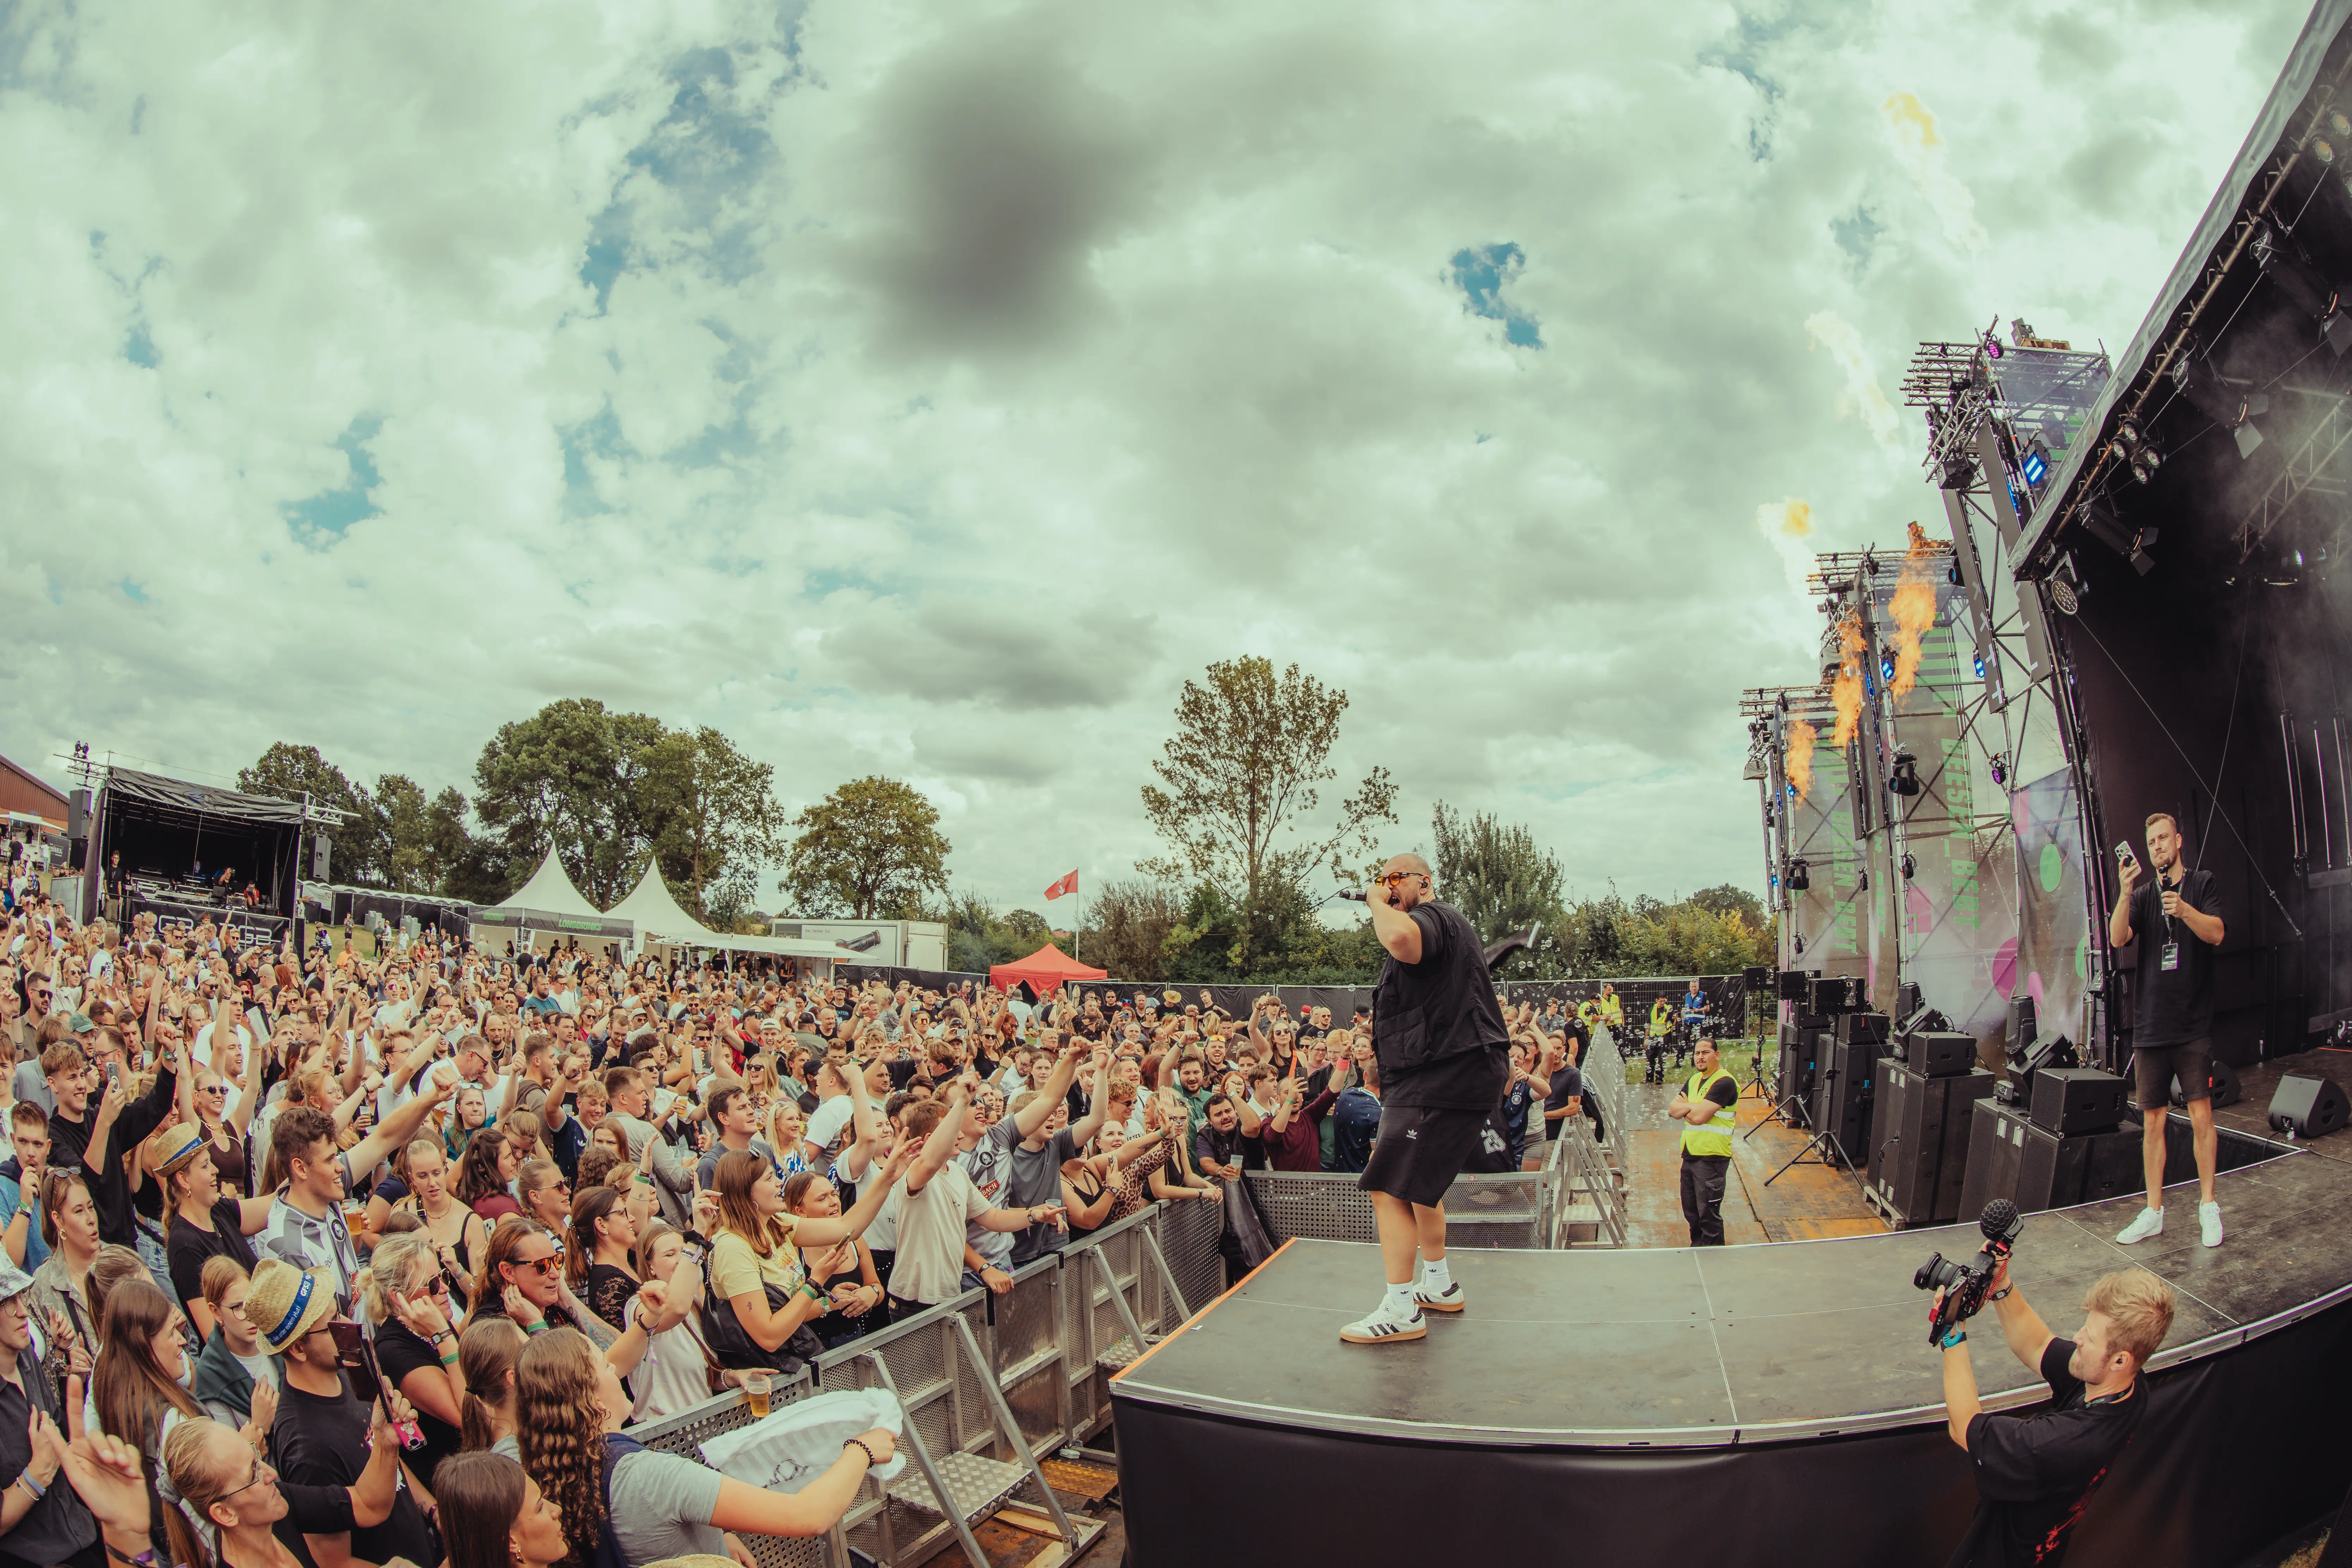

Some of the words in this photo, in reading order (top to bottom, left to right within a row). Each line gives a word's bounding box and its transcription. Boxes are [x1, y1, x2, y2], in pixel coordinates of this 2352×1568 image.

[558, 919, 602, 931] LONGDRINKS
[285, 1317, 295, 1330] einem
[293, 1305, 301, 1317] Hut!
